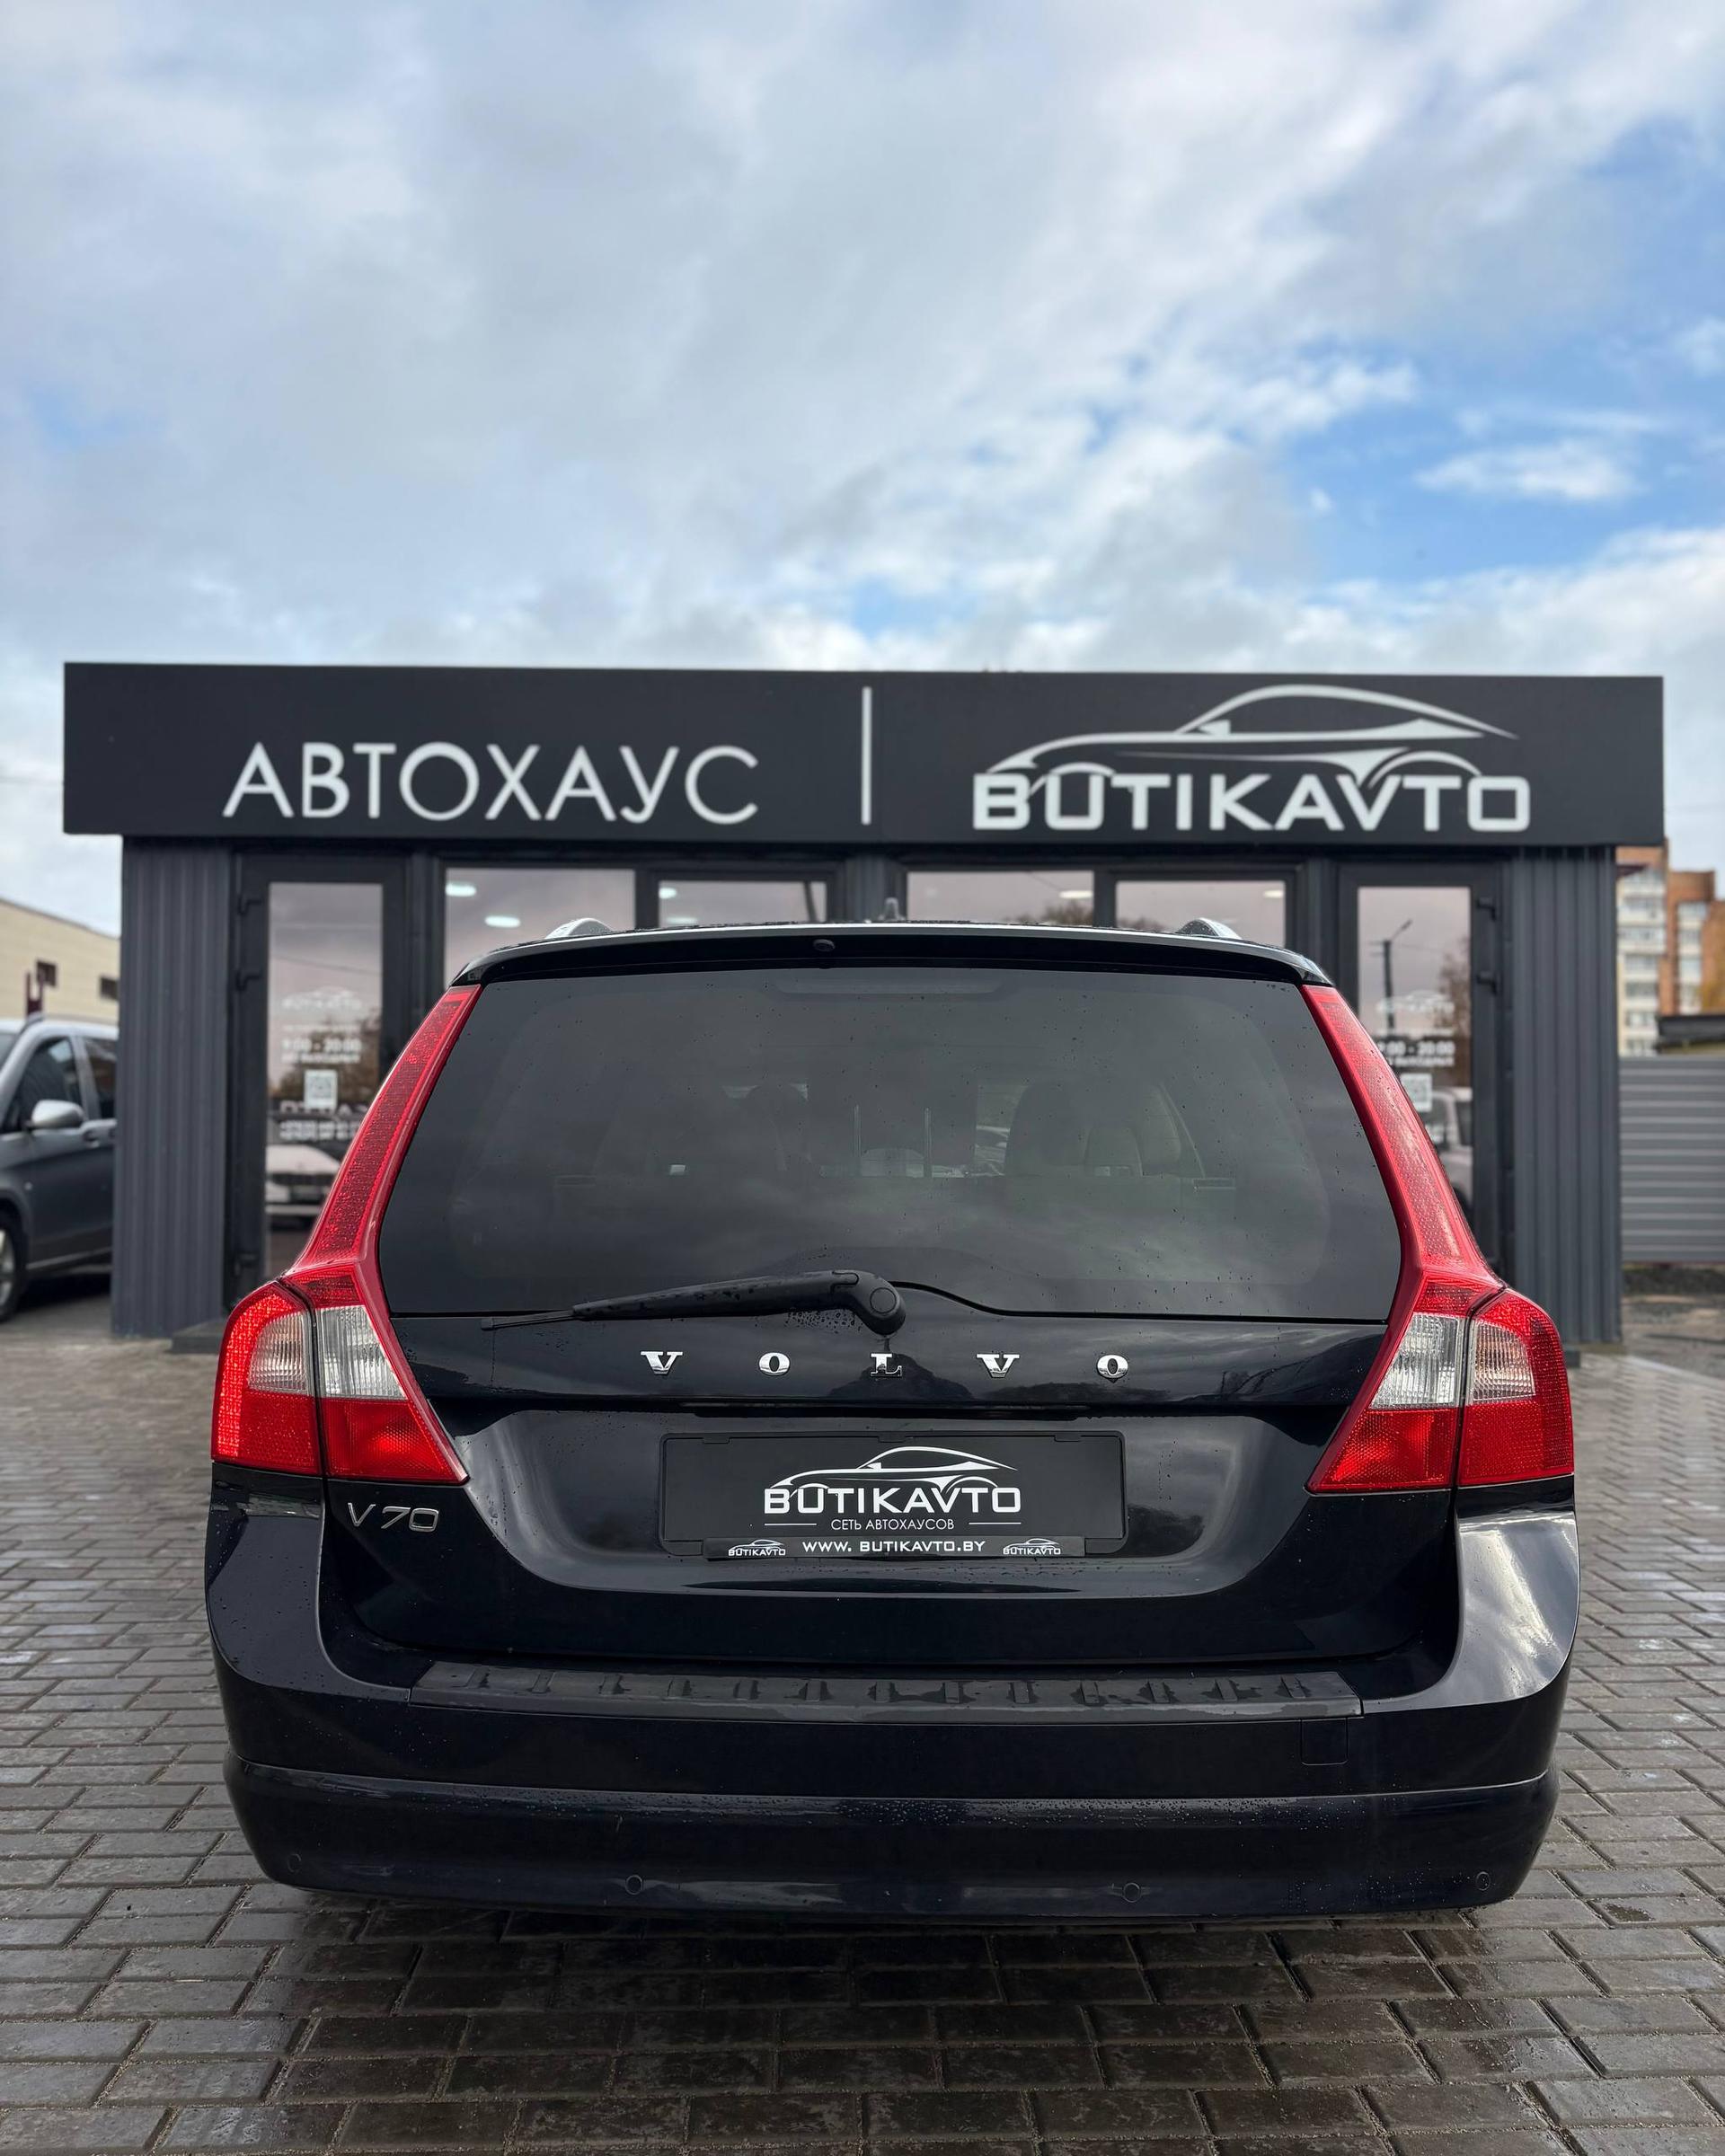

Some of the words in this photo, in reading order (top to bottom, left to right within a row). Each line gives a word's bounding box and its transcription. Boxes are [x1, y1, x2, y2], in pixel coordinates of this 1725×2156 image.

[223, 741, 759, 825] АВТОХАУС
[973, 773, 1531, 832] BUTIKAVTO
[640, 1350, 1129, 1379] VOLVO
[764, 1487, 1022, 1514] BUTIKAVTO
[830, 1518, 862, 1531] СЕТЬ
[865, 1518, 955, 1531] АВТОХАУСОВ
[728, 1548, 786, 1557] BUTIKAVTO
[1002, 1546, 1062, 1555] BUTIKAVTO
